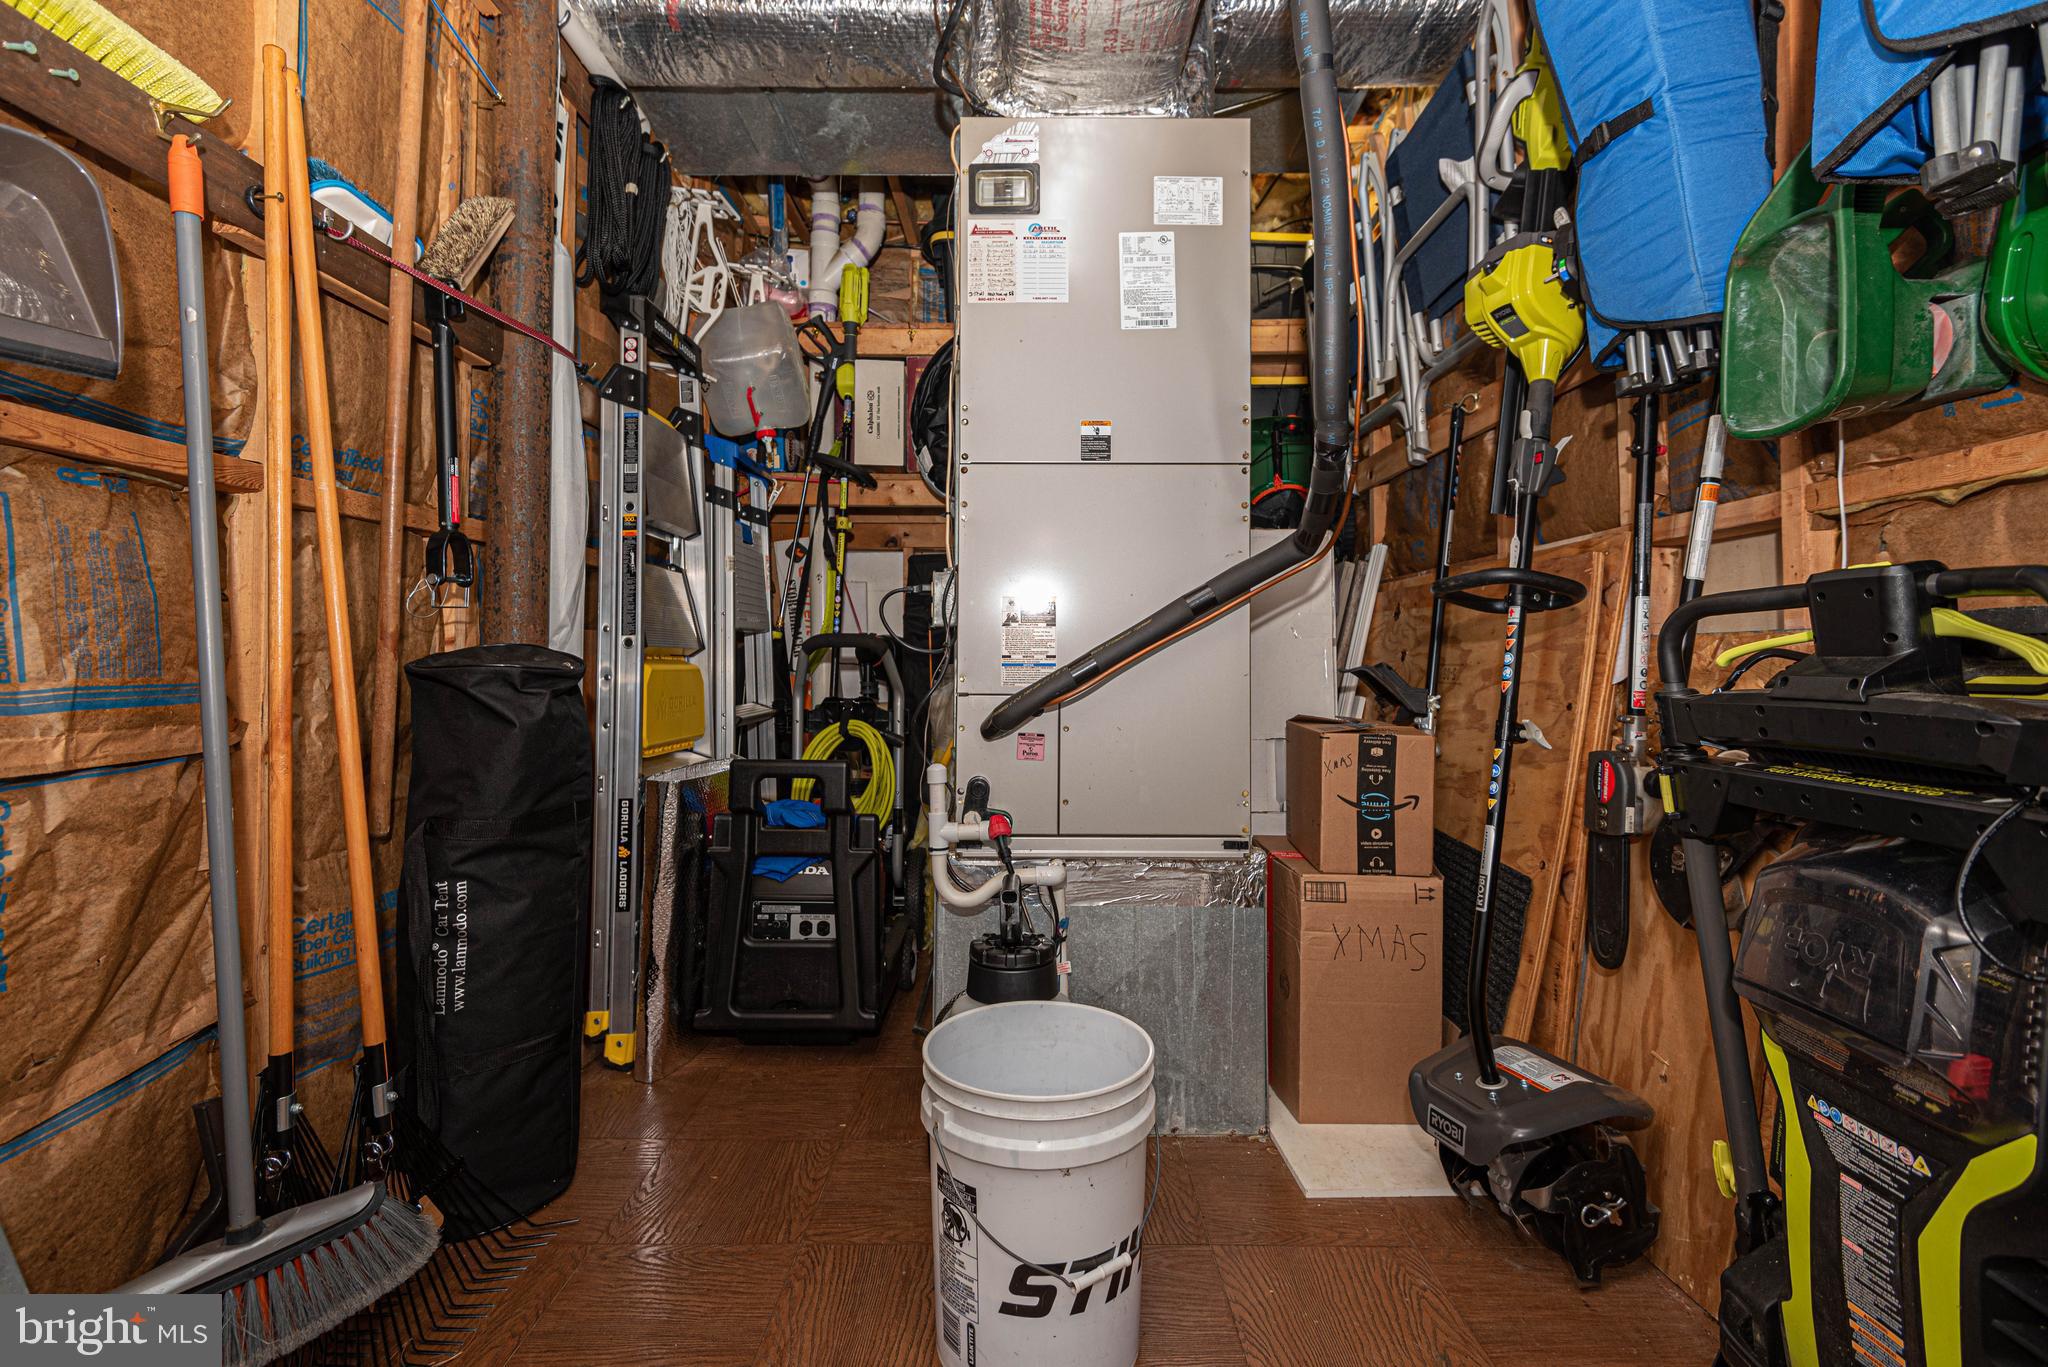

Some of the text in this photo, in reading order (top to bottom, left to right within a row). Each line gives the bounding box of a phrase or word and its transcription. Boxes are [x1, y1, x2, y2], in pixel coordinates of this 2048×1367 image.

[618, 799, 630, 908] GORILLA LADDERS
[434, 881, 449, 911] Tent
[1476, 875, 1487, 907] RYOBI
[435, 914, 449, 937] Car
[451, 880, 468, 1012] www.lanmodo.com
[1332, 923, 1428, 972] XMAS
[1431, 1112, 1462, 1143] RYOBI
